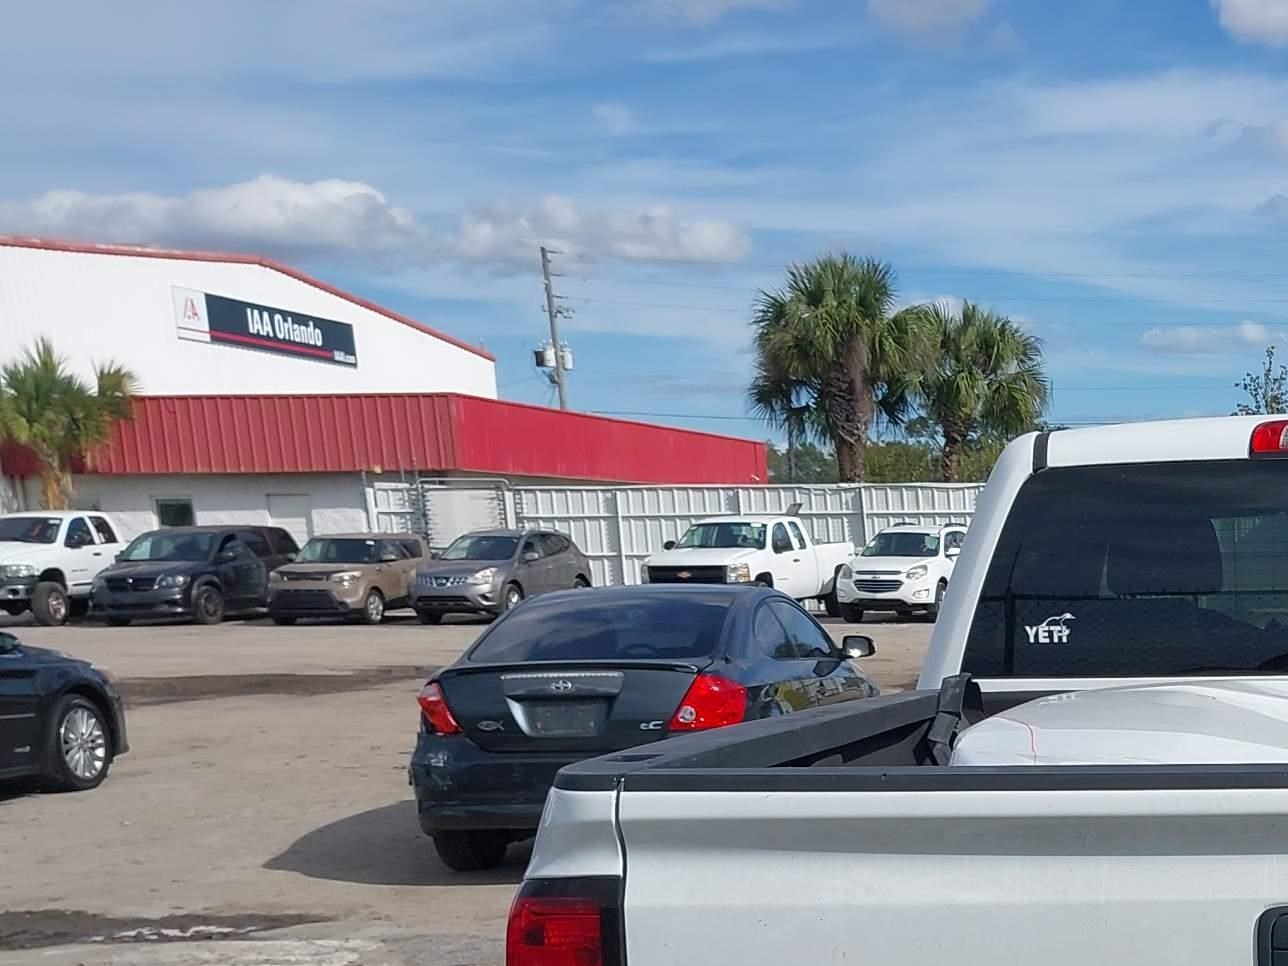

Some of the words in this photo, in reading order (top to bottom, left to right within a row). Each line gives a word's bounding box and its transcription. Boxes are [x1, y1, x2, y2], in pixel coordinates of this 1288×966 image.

[246, 307, 274, 338] IAA
[274, 313, 323, 347] Orlando
[1024, 626, 1070, 643] YETI
